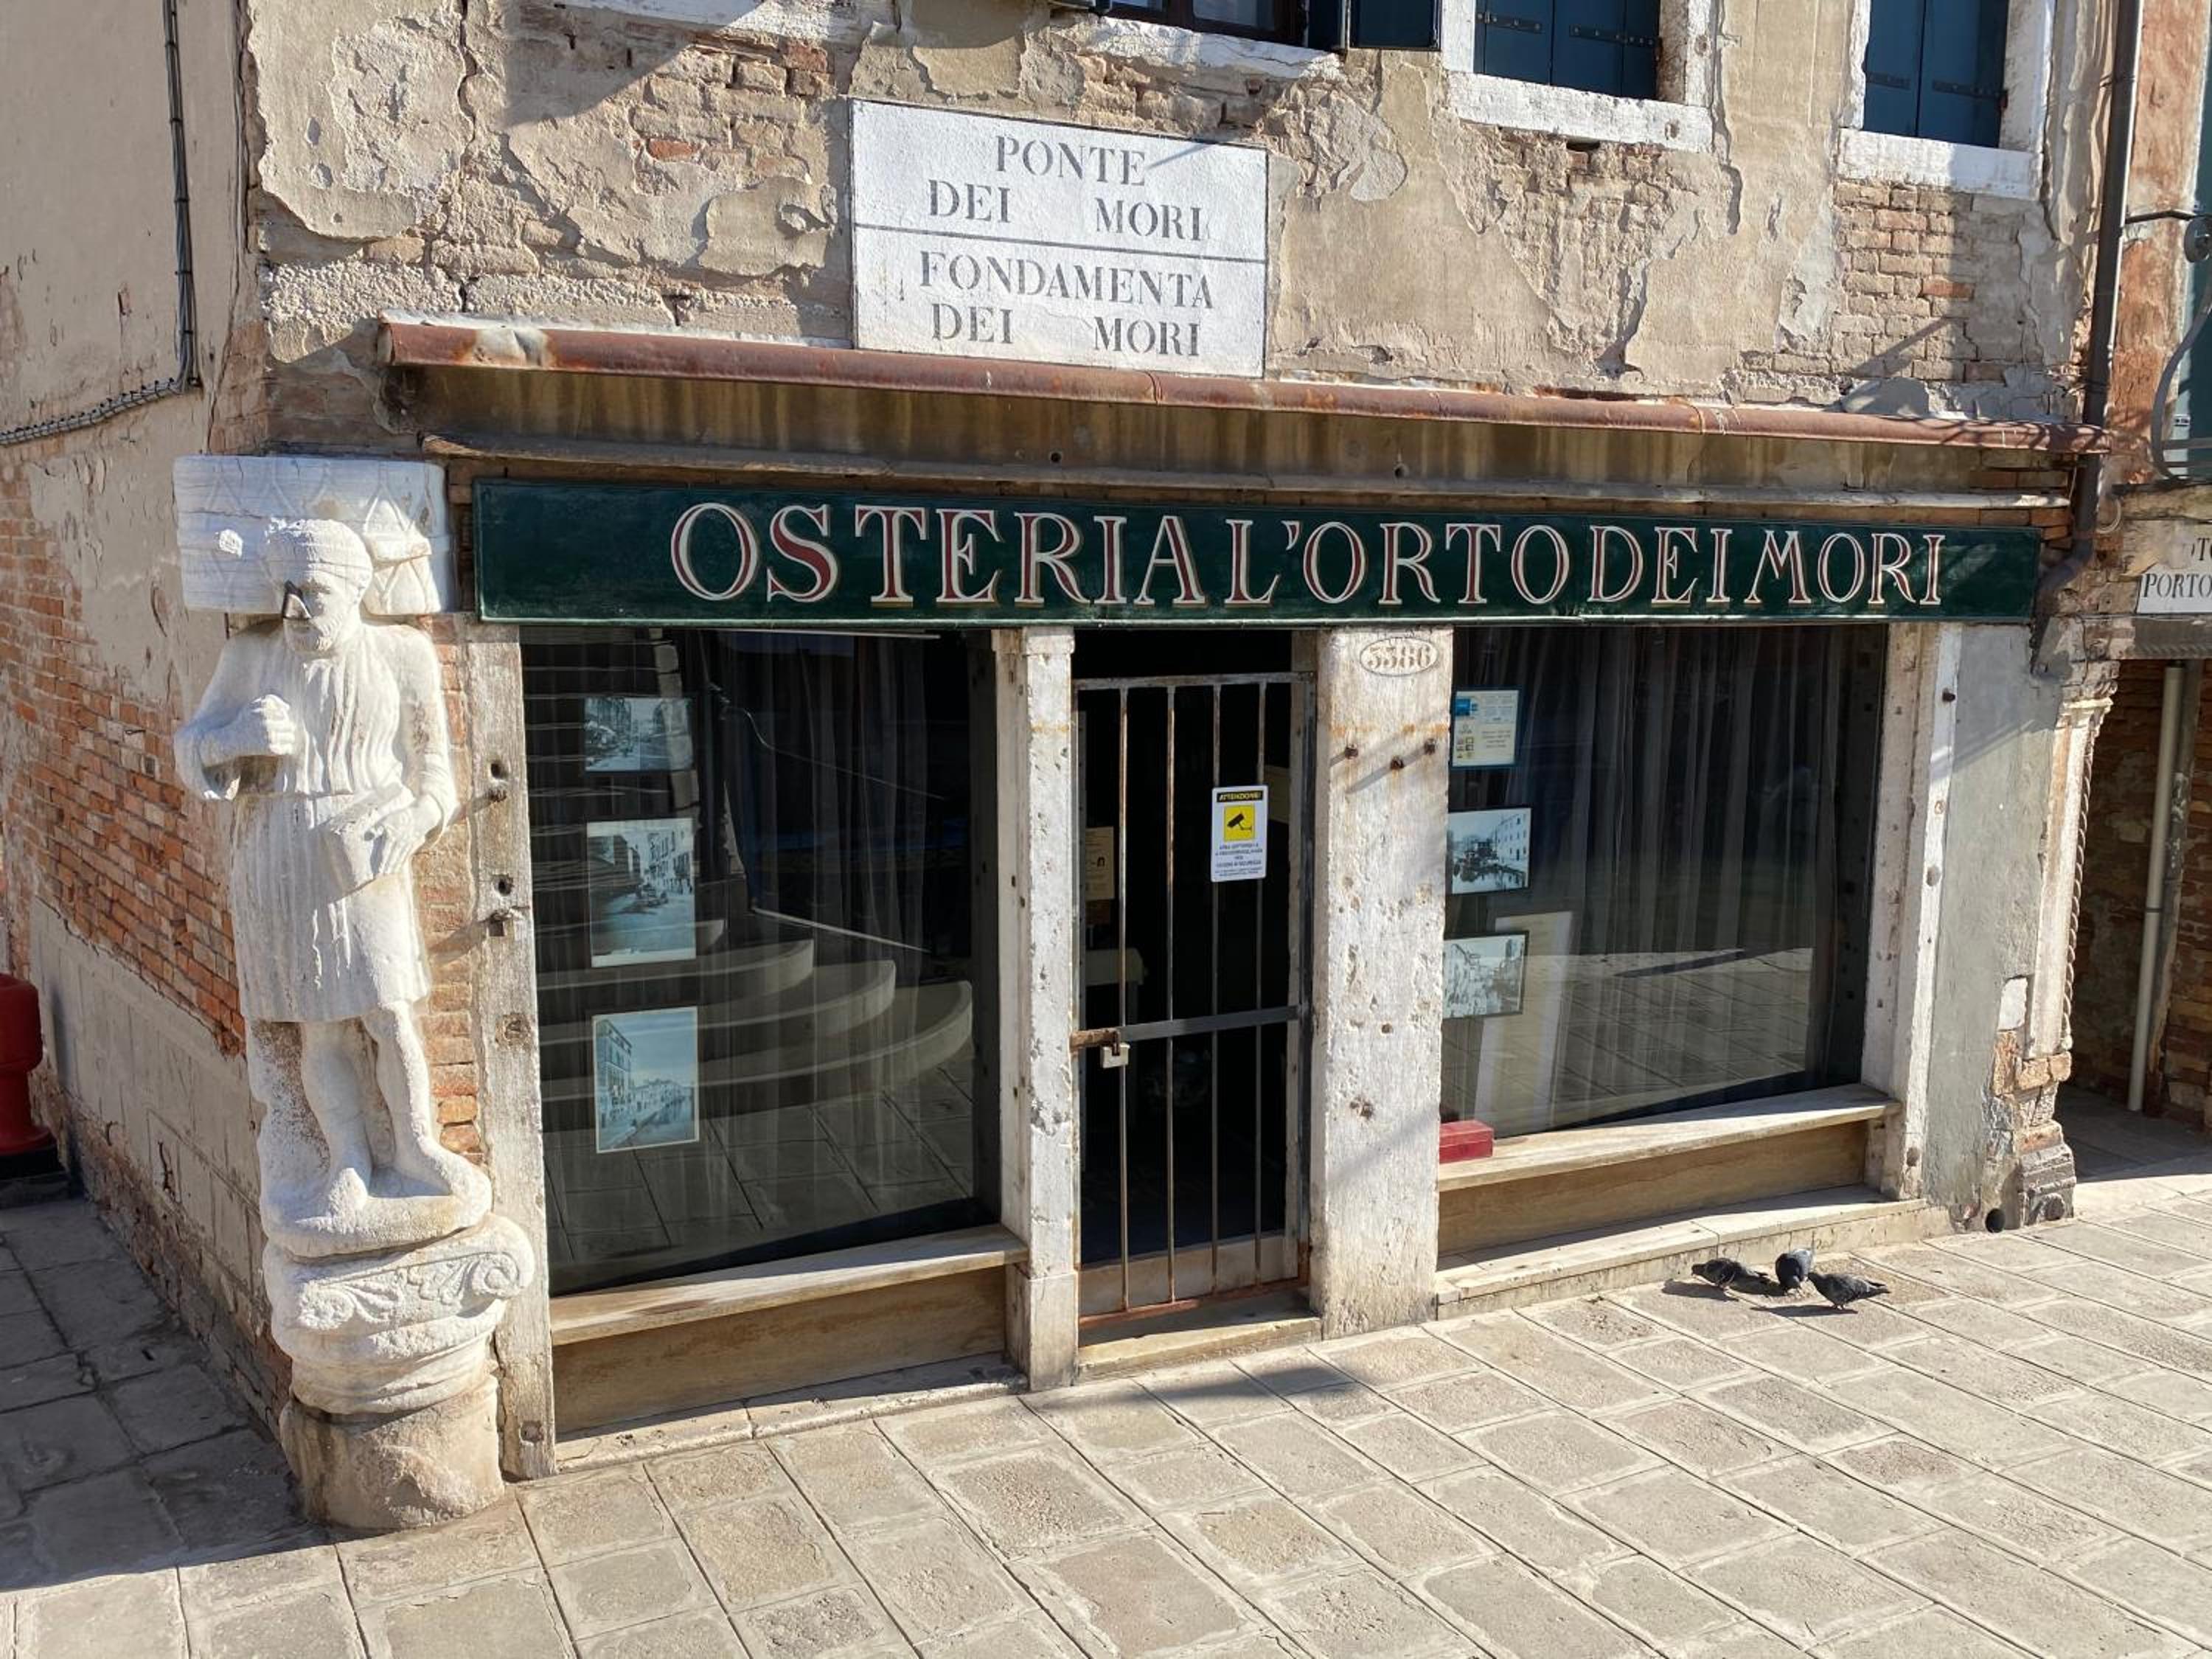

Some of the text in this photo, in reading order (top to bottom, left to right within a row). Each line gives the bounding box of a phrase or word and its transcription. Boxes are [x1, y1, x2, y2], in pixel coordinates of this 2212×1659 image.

[996, 134, 1146, 187] PONTE
[928, 178, 1204, 241] DEI MORI
[920, 250, 1214, 310] FONDAMENTA
[932, 302, 1201, 357] DEI MORI
[670, 502, 1947, 608] OSTERIA L'ORTO DEI MORI
